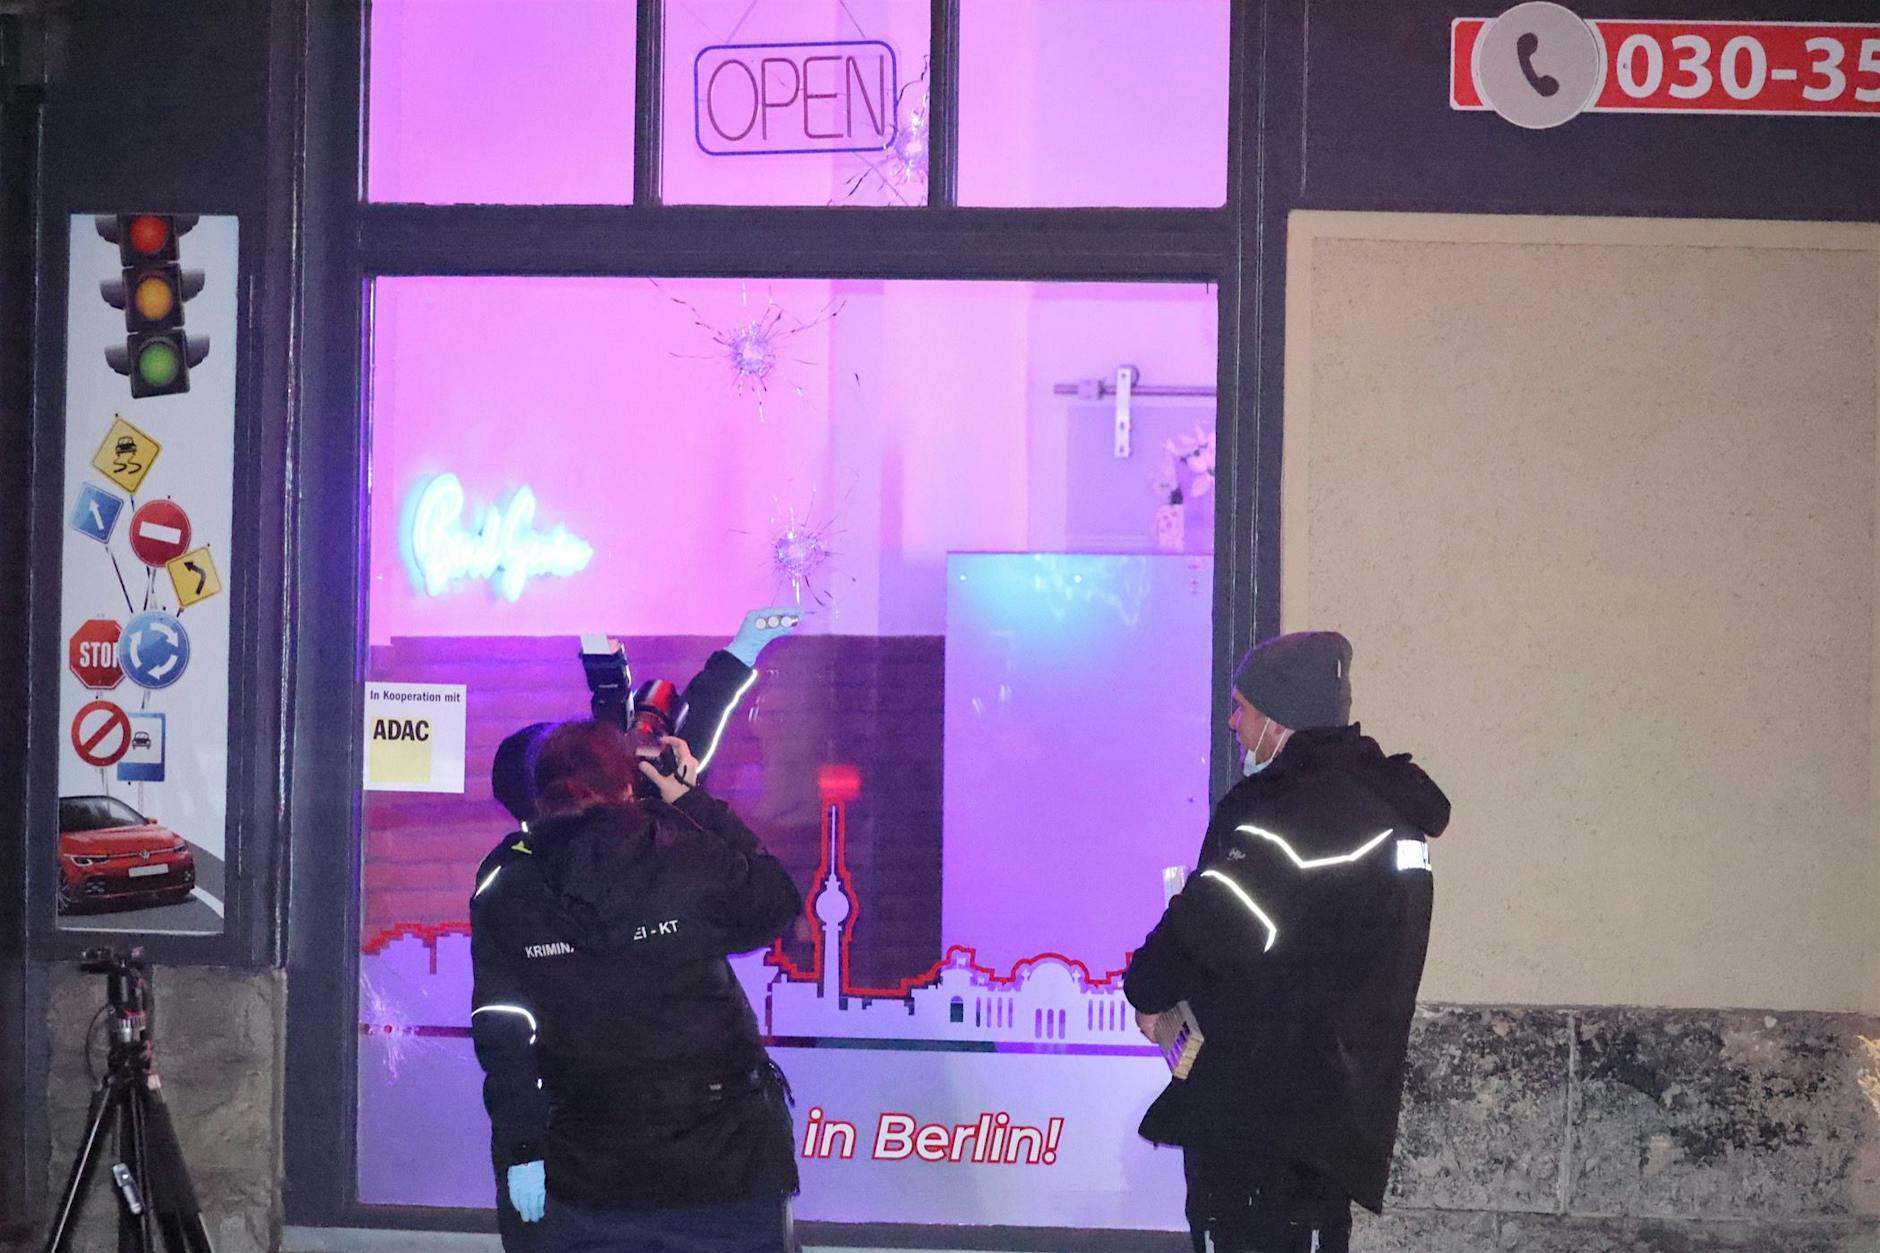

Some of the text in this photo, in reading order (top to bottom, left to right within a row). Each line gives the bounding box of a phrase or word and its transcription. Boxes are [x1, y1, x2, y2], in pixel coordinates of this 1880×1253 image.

[707, 54, 885, 141] OPEN
[370, 690, 461, 703] In Kooperation mit
[373, 719, 429, 741] ADAC
[525, 941, 575, 958] KRIMIN
[802, 1107, 1064, 1165] in Berlin!
